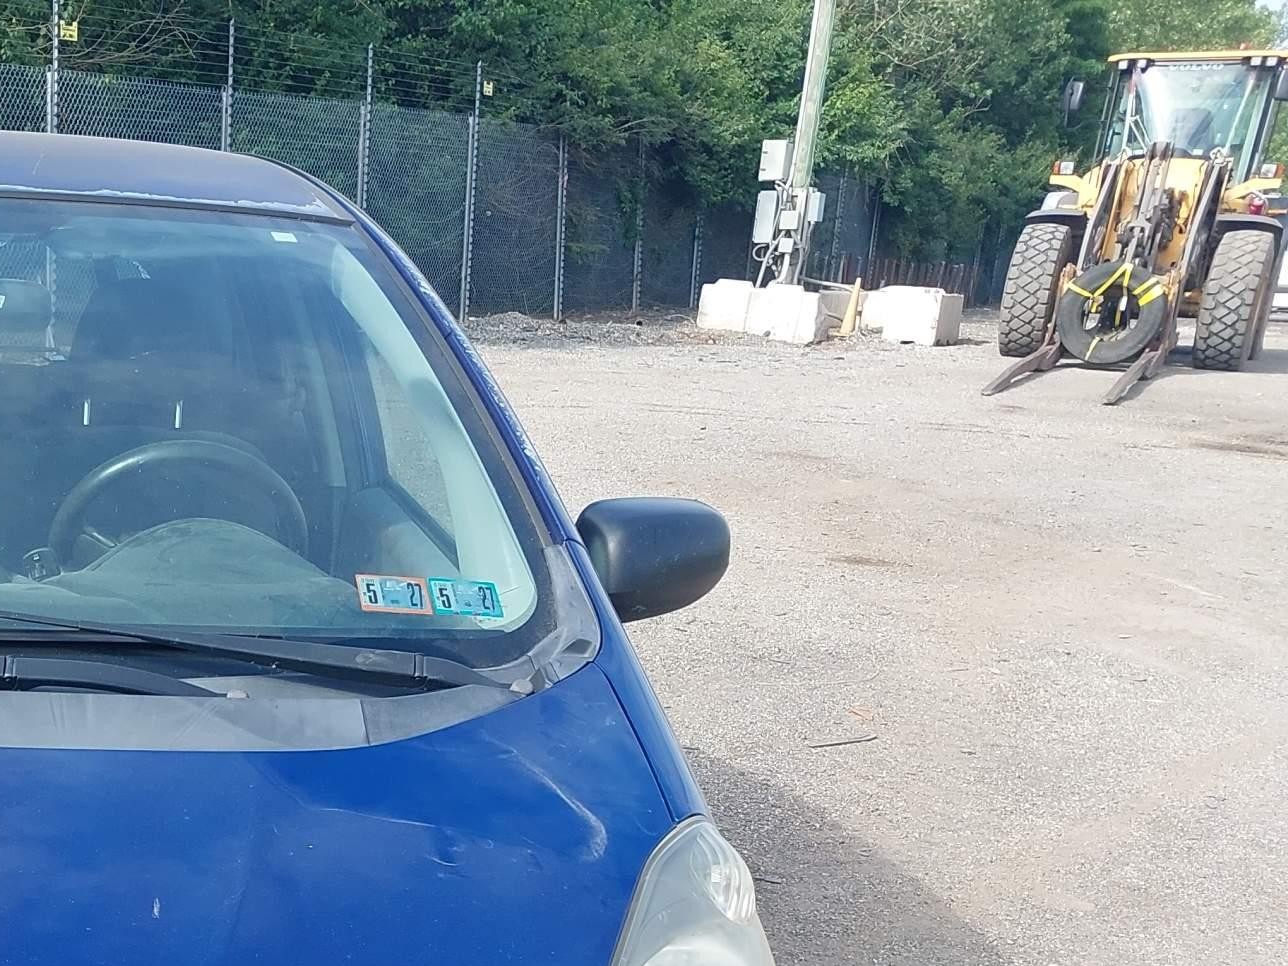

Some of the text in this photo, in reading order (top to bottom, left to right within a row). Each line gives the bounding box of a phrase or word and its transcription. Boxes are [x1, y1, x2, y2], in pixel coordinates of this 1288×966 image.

[365, 582, 424, 610] 5 27
[438, 587, 452, 610] 5
